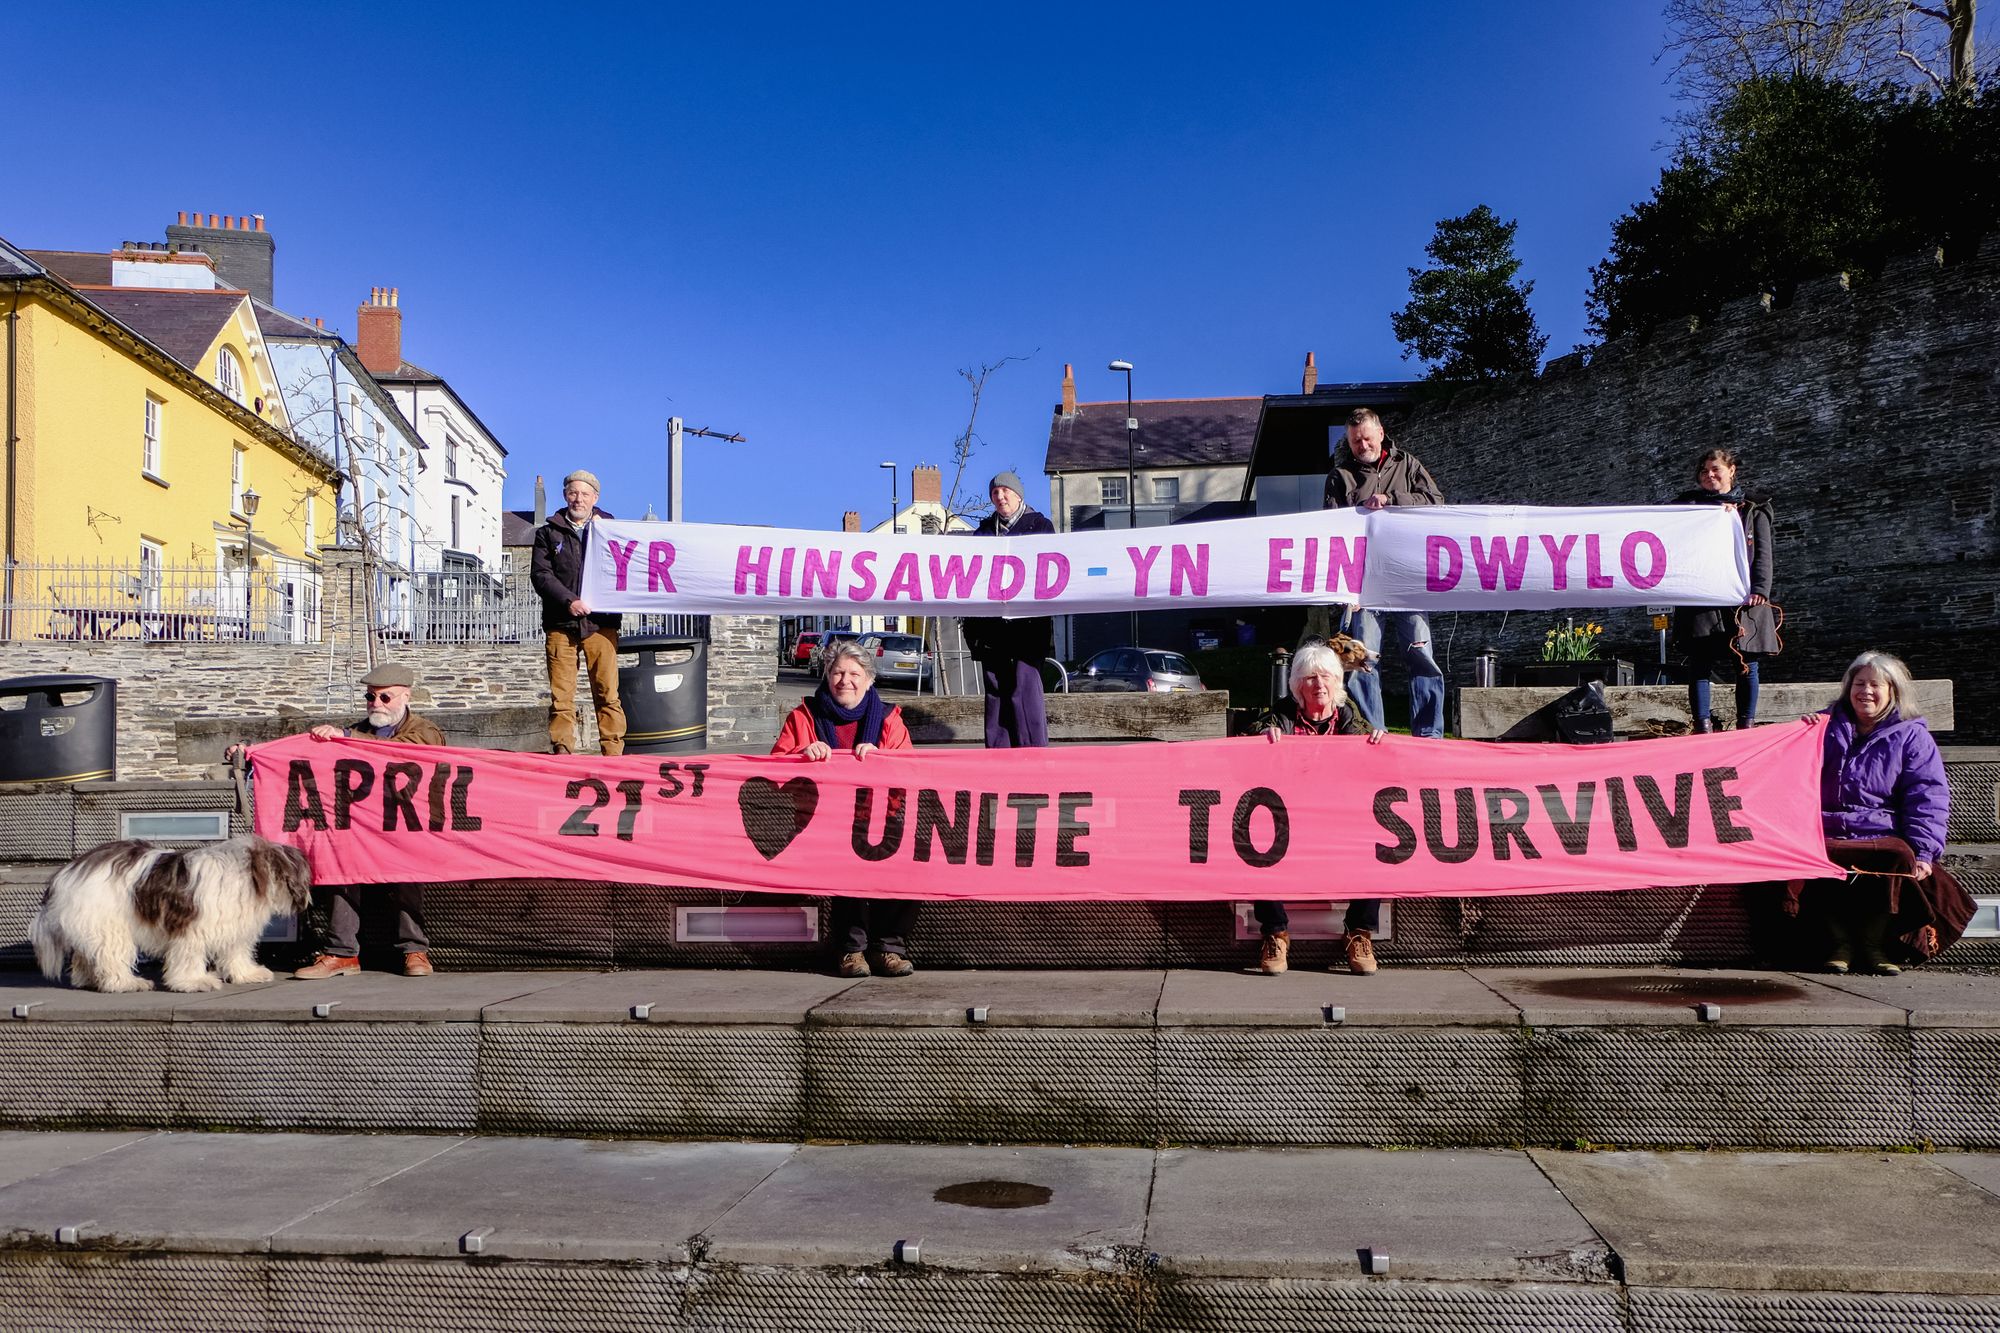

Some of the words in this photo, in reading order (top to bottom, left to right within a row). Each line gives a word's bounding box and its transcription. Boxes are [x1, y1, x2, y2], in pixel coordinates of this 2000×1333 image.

[607, 540, 677, 593] YR
[733, 546, 1071, 602] HINSAWDD
[1127, 544, 1210, 598] YN
[1266, 536, 1368, 593] EIN
[1425, 531, 1667, 593] DWYLO
[282, 758, 482, 832] APRIL
[851, 787, 1093, 868] UNITE
[1178, 787, 1290, 868] TO
[1373, 766, 1754, 865] SURVIVE
